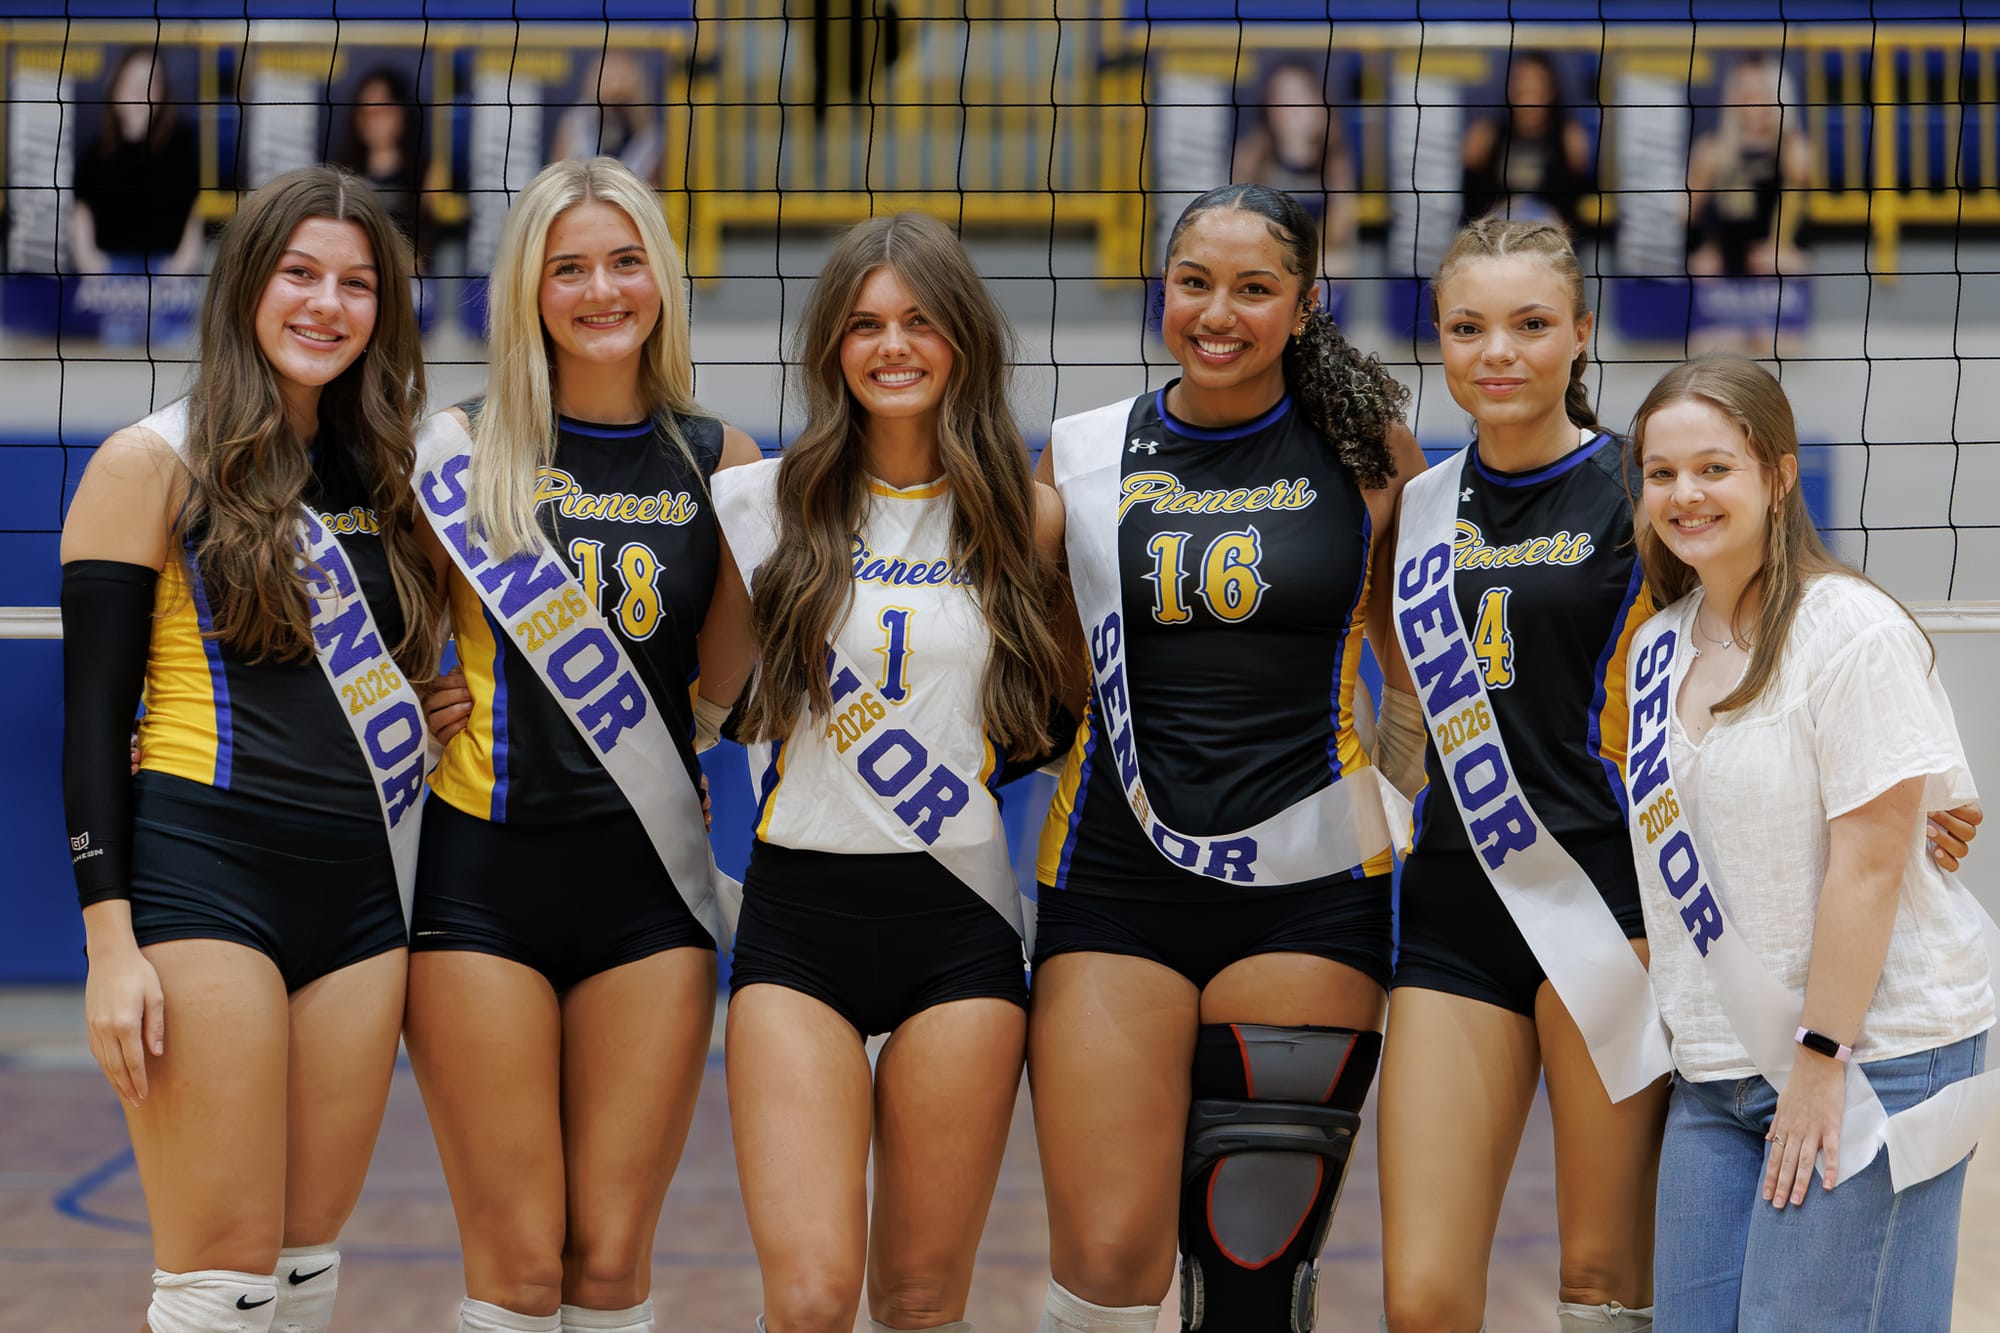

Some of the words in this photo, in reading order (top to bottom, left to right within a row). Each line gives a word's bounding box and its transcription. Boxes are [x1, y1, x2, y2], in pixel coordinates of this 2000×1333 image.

[533, 465, 698, 526] Pioneers
[1117, 471, 1317, 525] Pioneers
[568, 537, 667, 642] 18
[1140, 524, 1273, 625] 16
[515, 588, 588, 653] 2026
[1472, 586, 1515, 690] 4
[872, 605, 917, 706] 1
[341, 661, 402, 716] 2026
[827, 692, 887, 754] 2026
[1437, 699, 1491, 756] 2026
[1639, 788, 1681, 845] 2026
